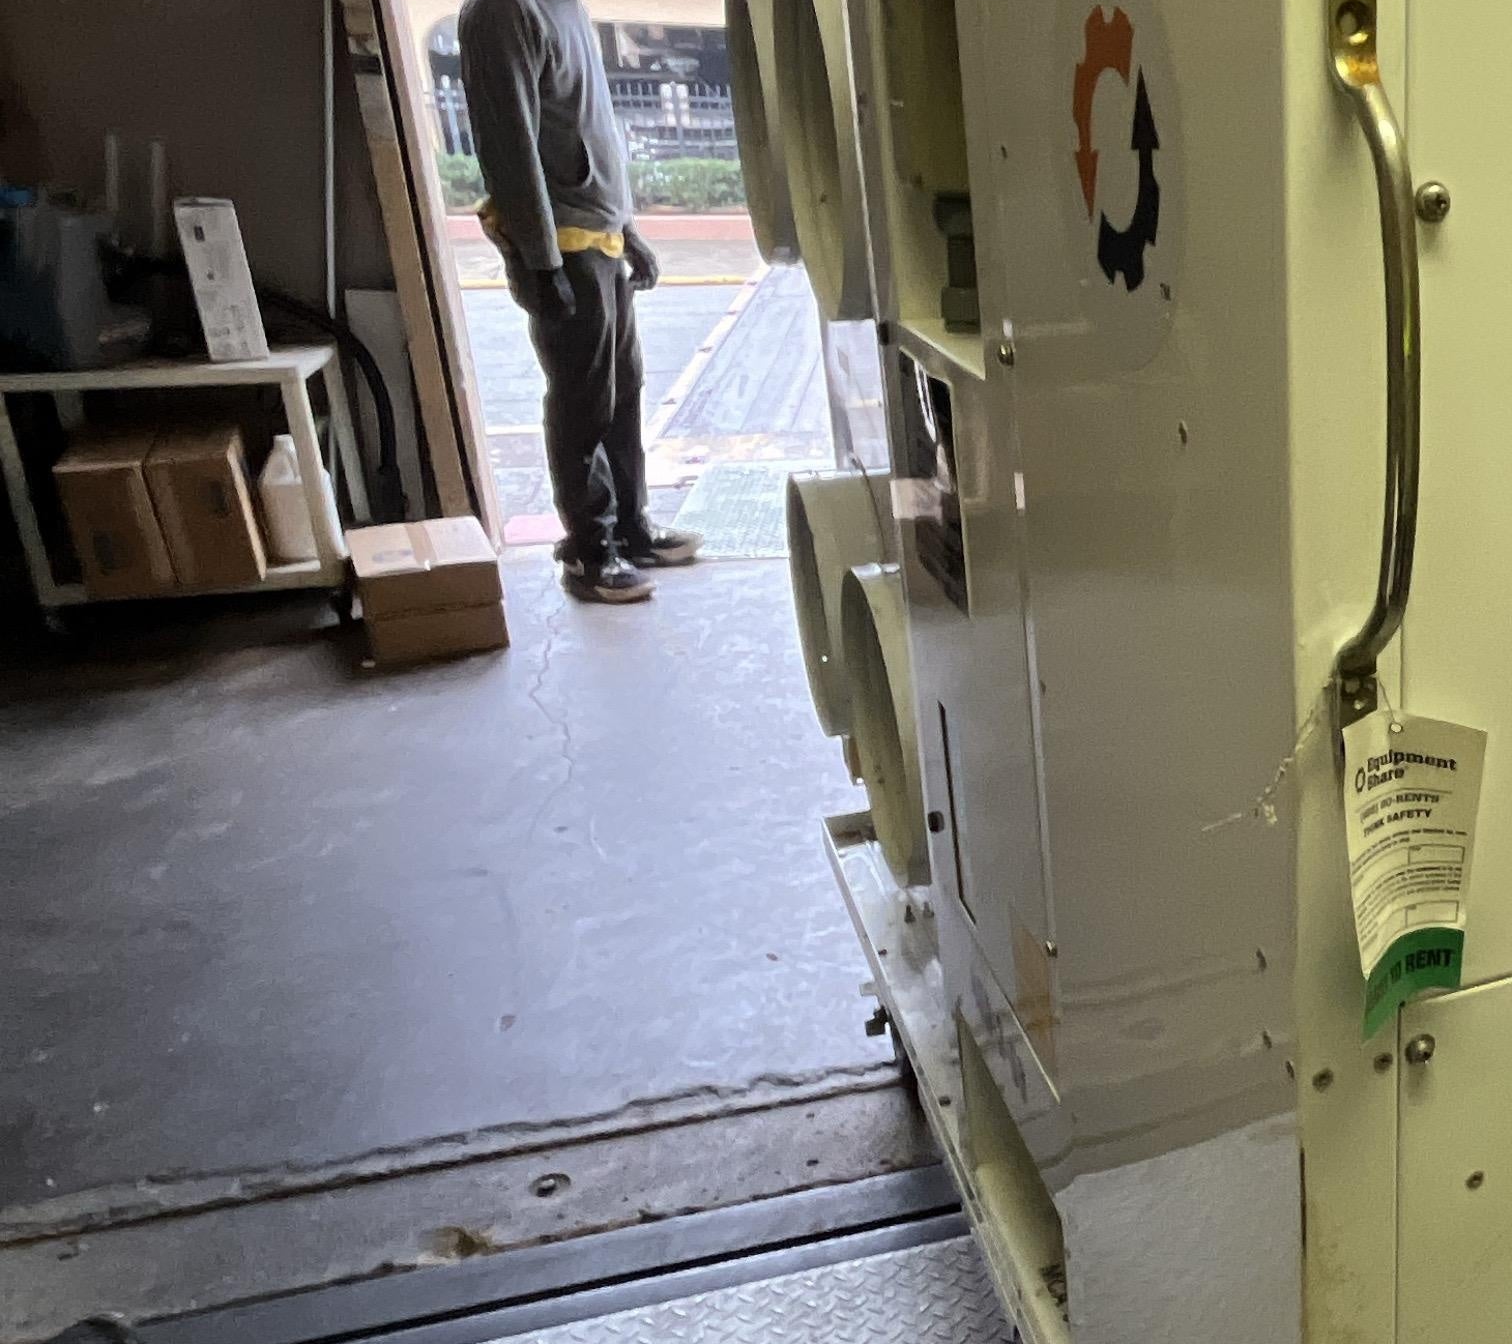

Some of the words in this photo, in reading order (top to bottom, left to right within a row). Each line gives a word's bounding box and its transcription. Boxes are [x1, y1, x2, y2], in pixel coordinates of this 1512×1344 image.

[1367, 749, 1457, 773] Equipment
[1367, 768, 1405, 791] Share
[1387, 809, 1432, 823] SAFETY
[1405, 948, 1453, 974] RENT
